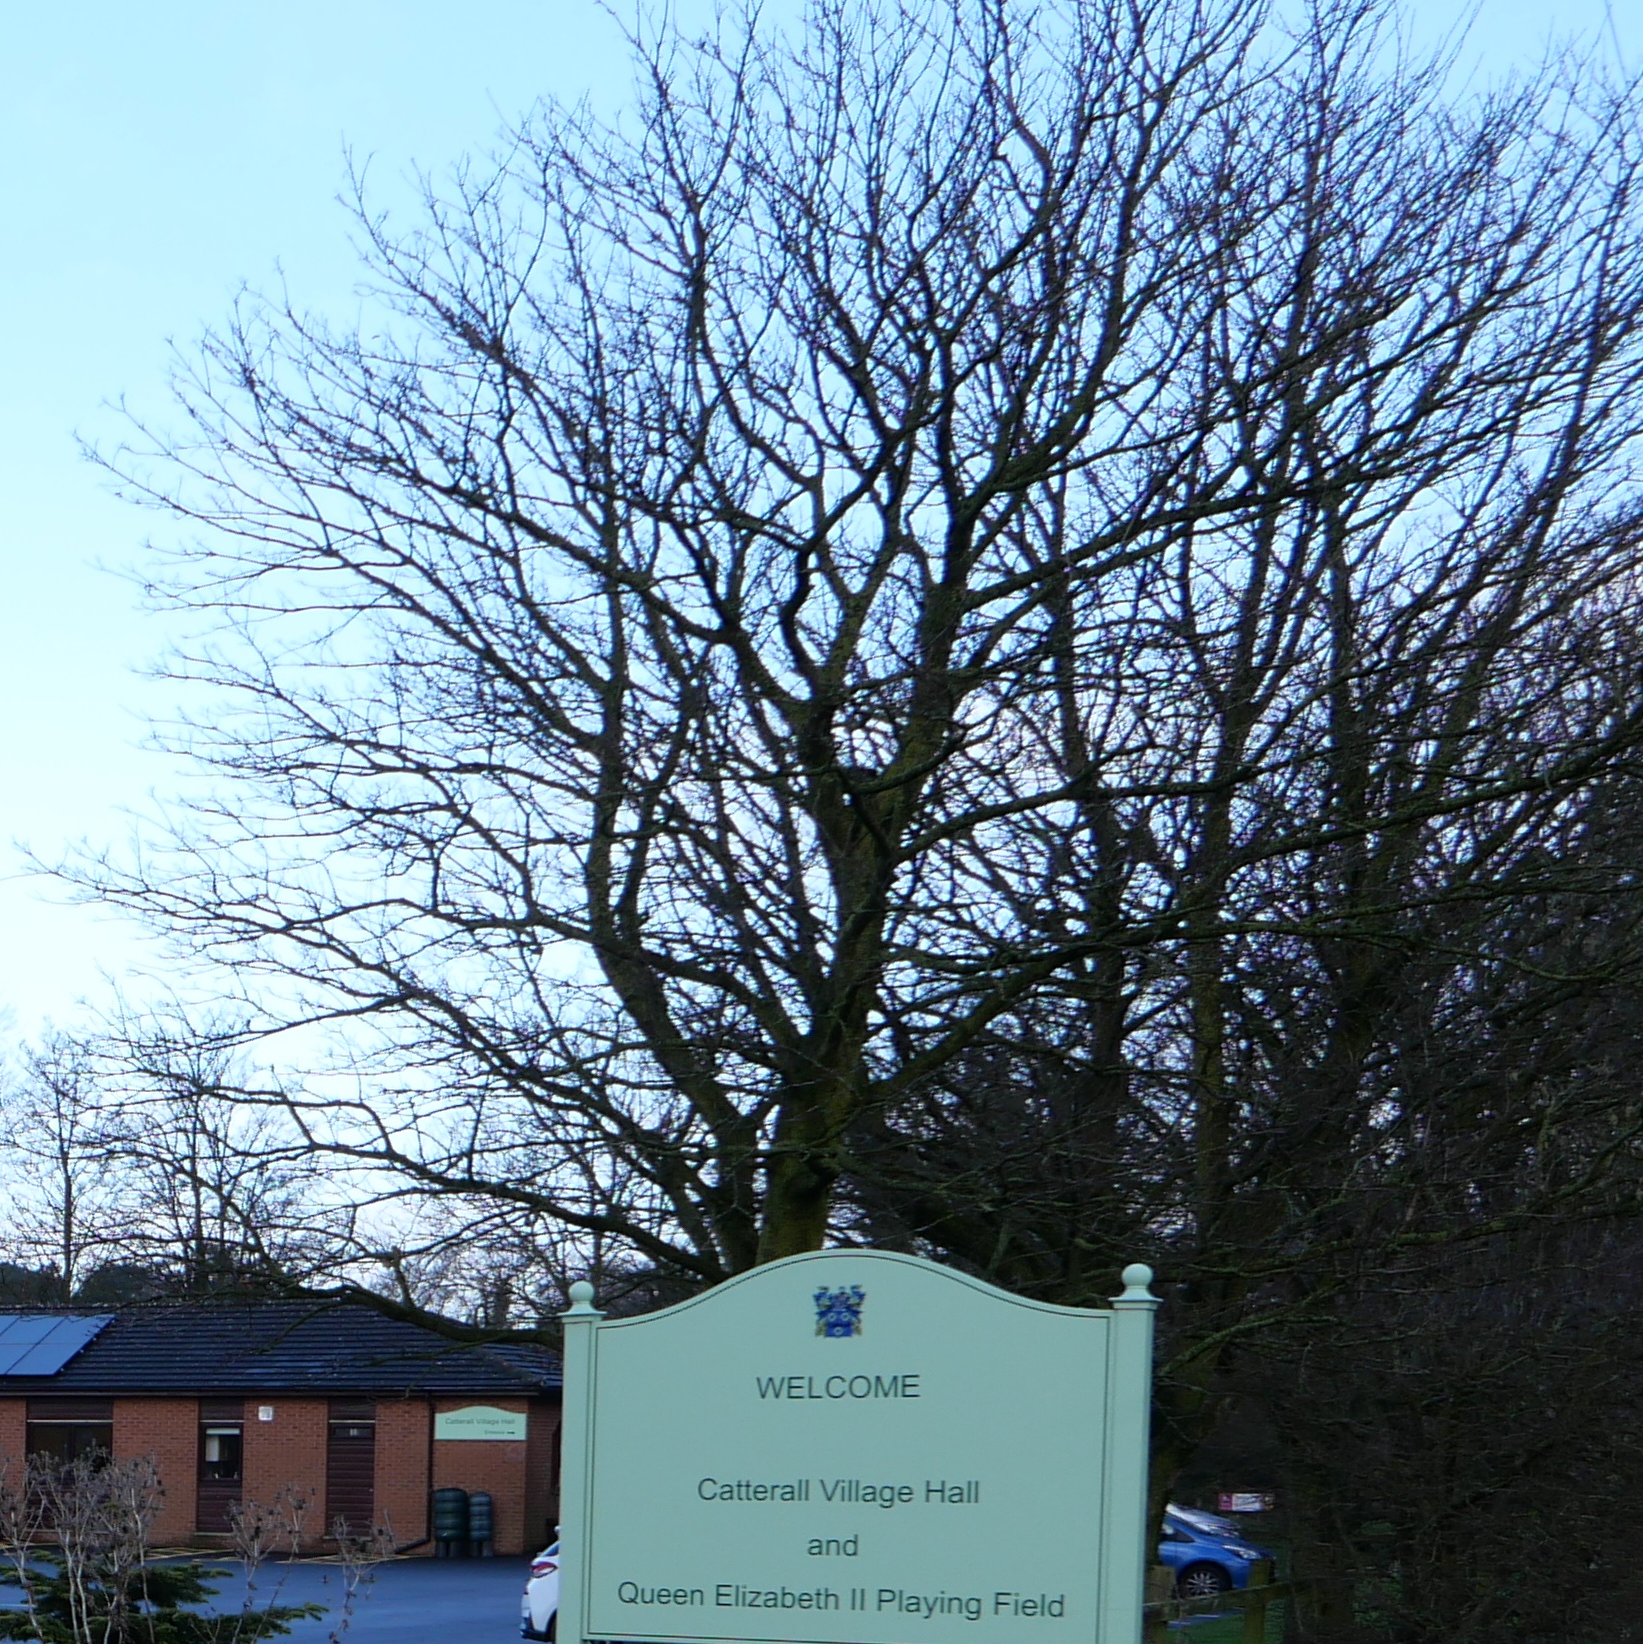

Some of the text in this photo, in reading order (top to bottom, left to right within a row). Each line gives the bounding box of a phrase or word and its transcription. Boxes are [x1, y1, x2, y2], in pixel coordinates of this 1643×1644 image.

[756, 1375, 921, 1400] WELCOME
[476, 1418, 499, 1426] Village
[698, 1477, 980, 1510] Catterall Village Hall
[807, 1534, 859, 1558] and
[618, 1580, 1065, 1622] Queen Elizabeth II Playing Field
